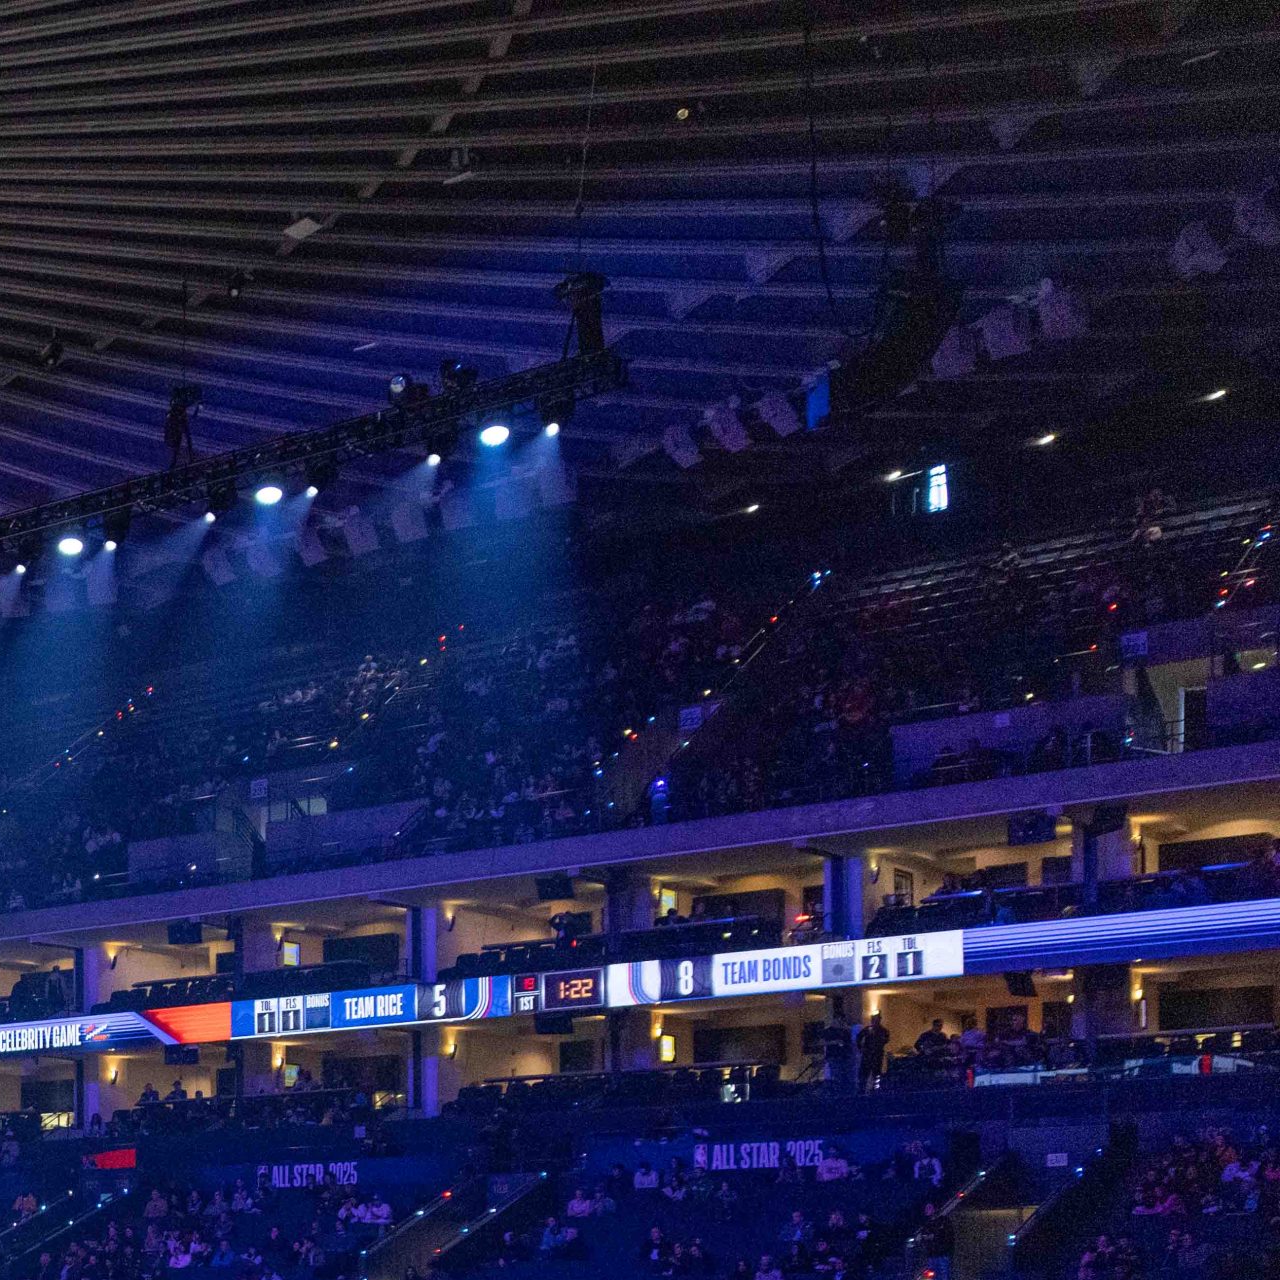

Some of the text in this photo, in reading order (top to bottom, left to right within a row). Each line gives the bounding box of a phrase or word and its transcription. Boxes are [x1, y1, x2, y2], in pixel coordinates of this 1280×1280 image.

[866, 939, 882, 954] FLS
[677, 955, 812, 996] 8 TEAM BONDS
[868, 952, 915, 979] 2 1
[285, 998, 297, 1010] FLS
[344, 984, 447, 1021] TEAM RICE 5
[518, 978, 593, 1012] 1ST 1:22
[263, 1011, 294, 1032] 1 1
[0, 1026, 51, 1053] CELEBRITY
[52, 1023, 82, 1048] GAME
[712, 1144, 737, 1170] ALL
[741, 1142, 779, 1168] STAR
[272, 1165, 291, 1188] ALL
